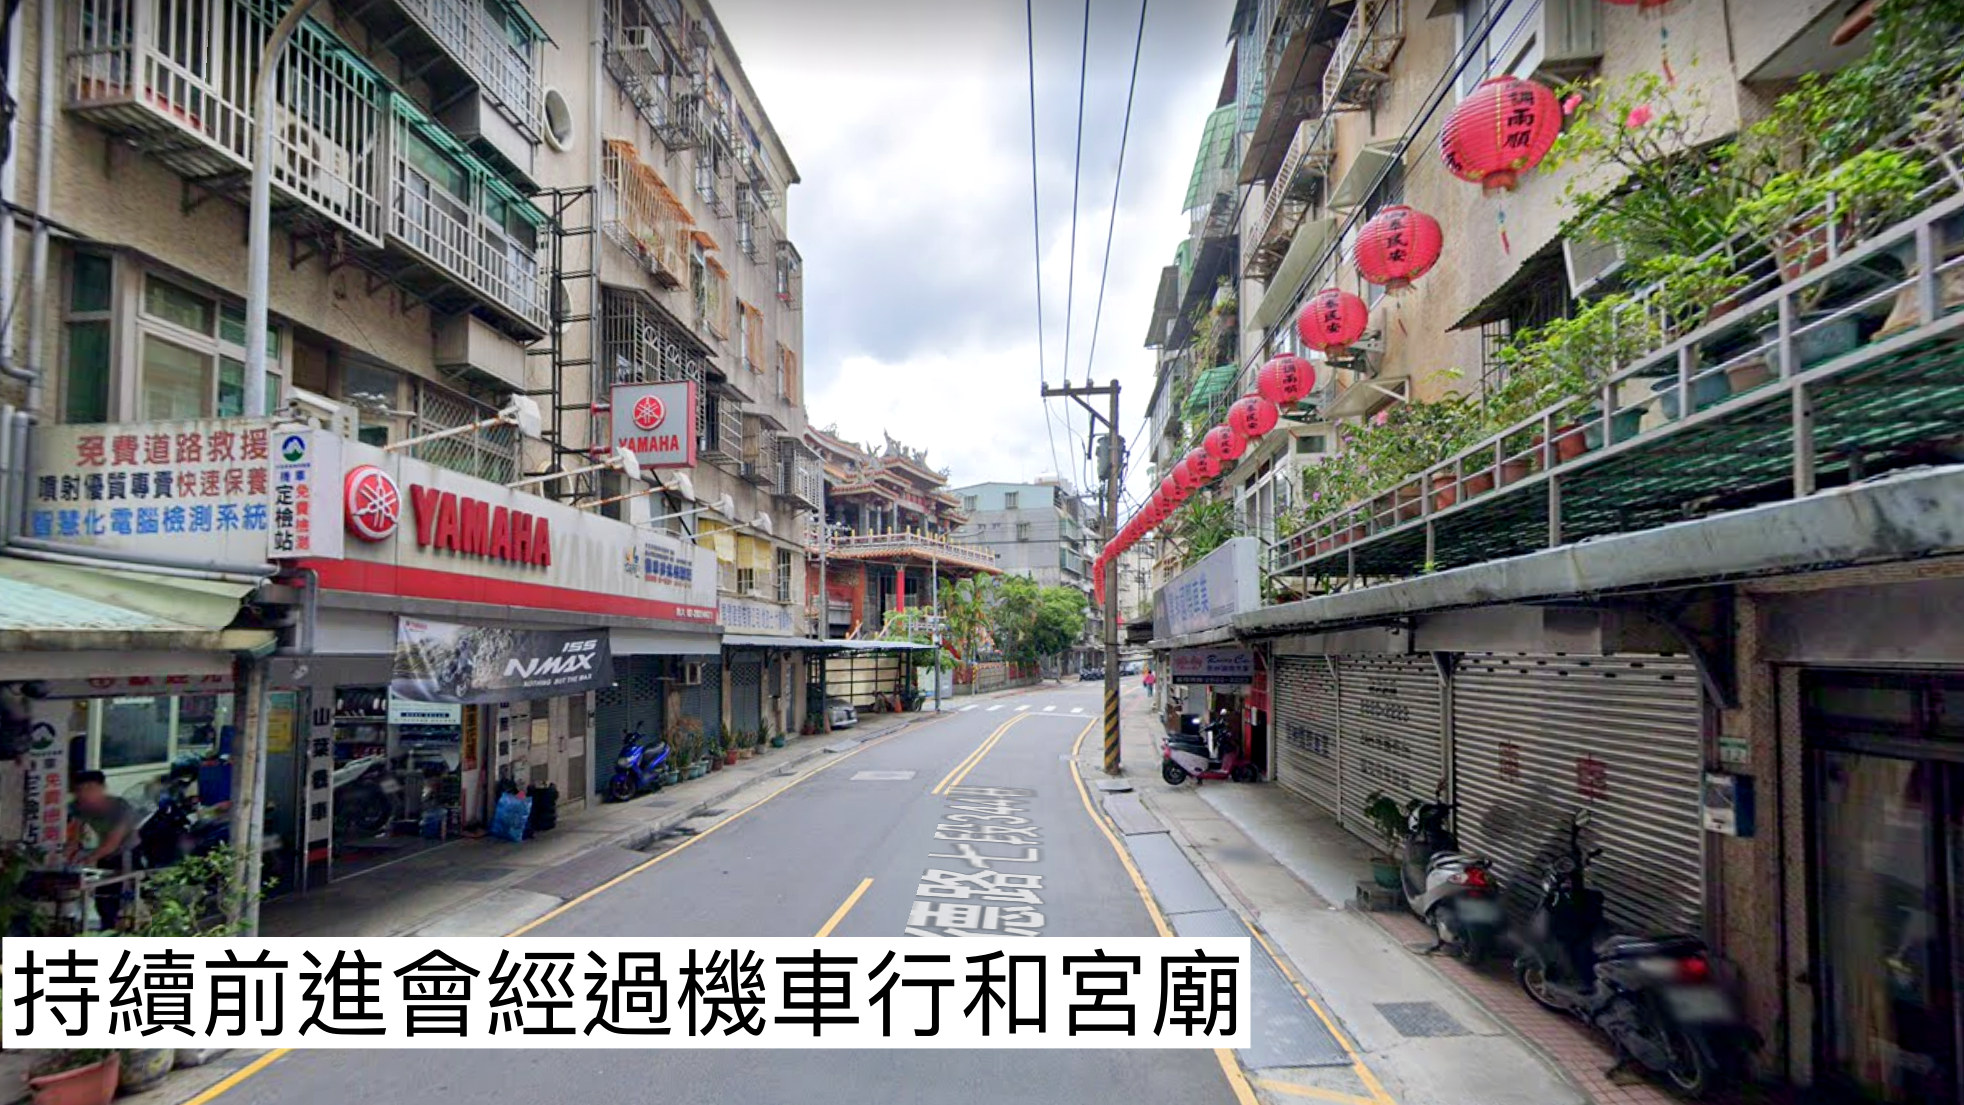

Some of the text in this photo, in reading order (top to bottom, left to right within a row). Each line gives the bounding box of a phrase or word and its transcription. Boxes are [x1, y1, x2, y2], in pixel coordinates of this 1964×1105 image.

[76, 428, 269, 467] 免費道路救援
[618, 434, 680, 453] YAMAHA
[31, 503, 268, 537] 智慧化電腦檢測系統
[409, 483, 552, 567] YAMAHA
[503, 652, 596, 678] NMAX
